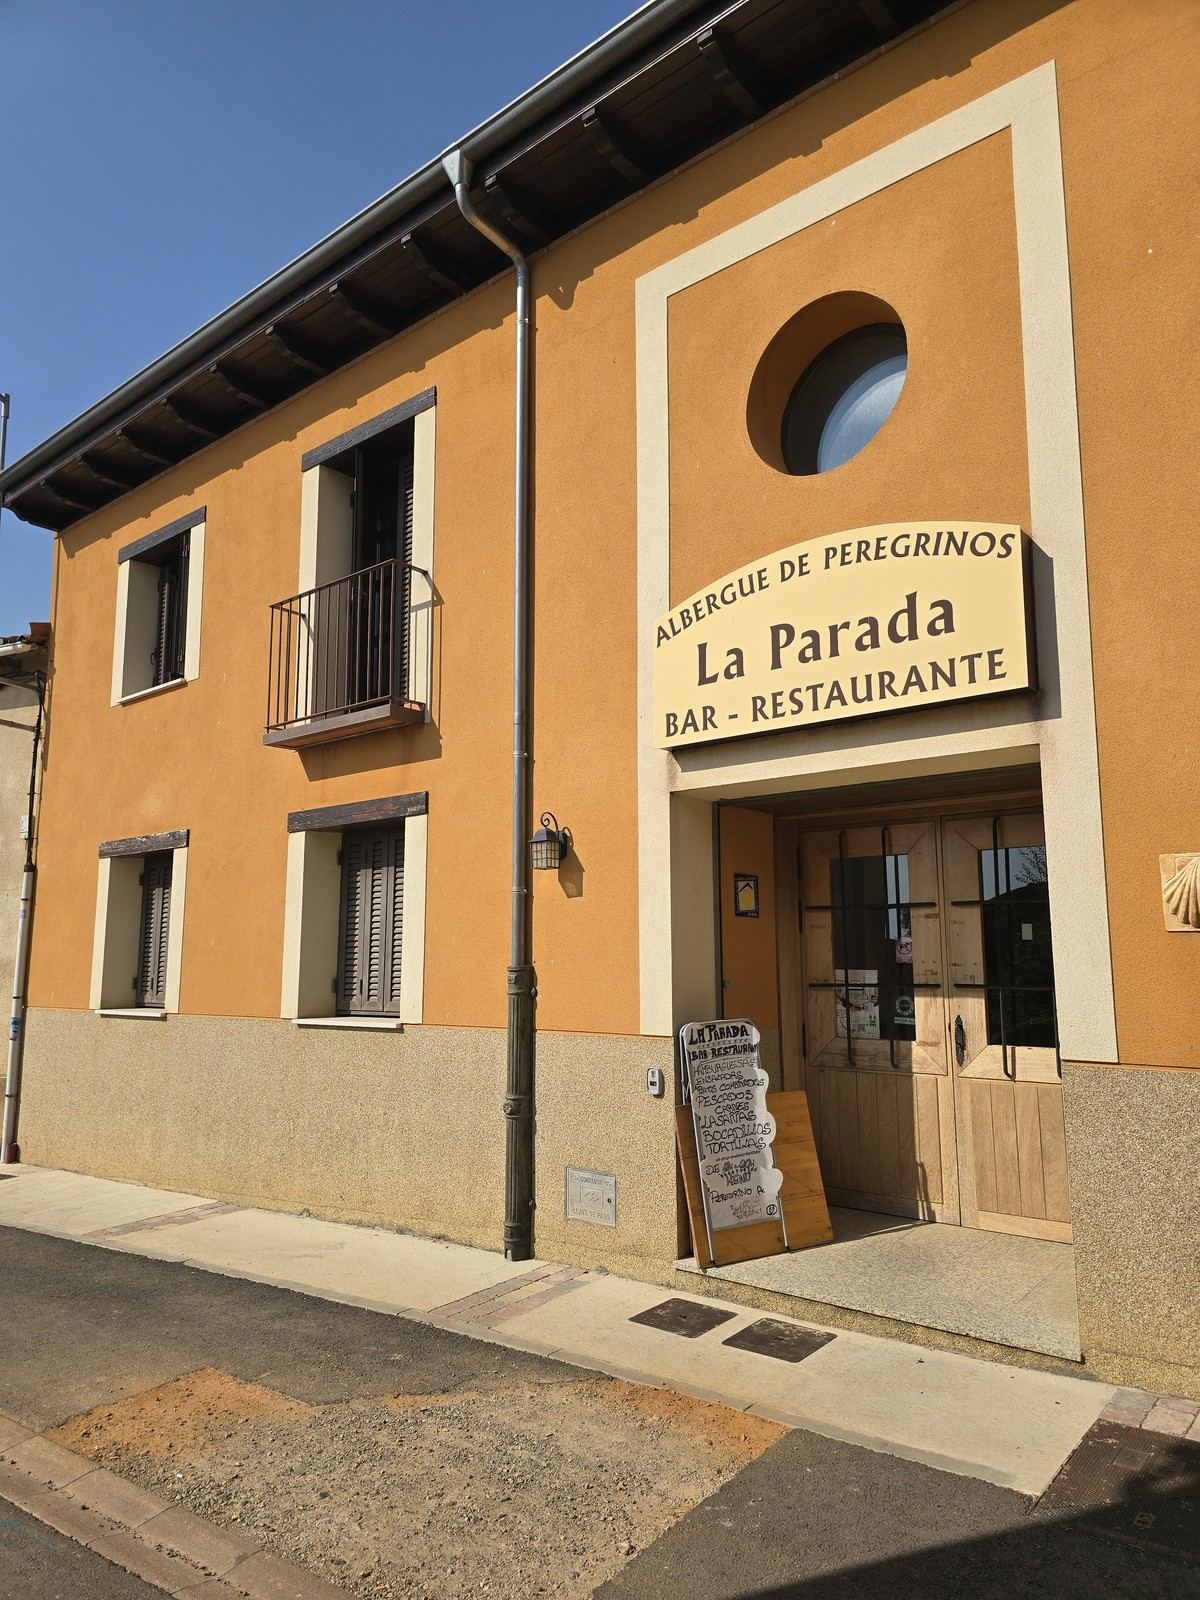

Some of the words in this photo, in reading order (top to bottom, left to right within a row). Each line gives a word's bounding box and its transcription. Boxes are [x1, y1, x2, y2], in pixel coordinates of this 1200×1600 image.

[657, 568, 770, 648] ALBERGUE
[780, 553, 811, 582] DE
[824, 532, 1015, 569] PEREGRINOS
[698, 642, 745, 686] La
[770, 591, 956, 670] Parada
[666, 706, 718, 737] BAR
[752, 648, 1007, 722] RESTAURANTE
[705, 1024, 750, 1042] PARADA
[691, 1049, 709, 1061] BAR
[694, 1058, 757, 1077] HAMBURGUESAS
[696, 1090, 754, 1107] PESCADOS
[714, 1102, 750, 1115] CARNES
[703, 1122, 772, 1142] BOCADILLOS
